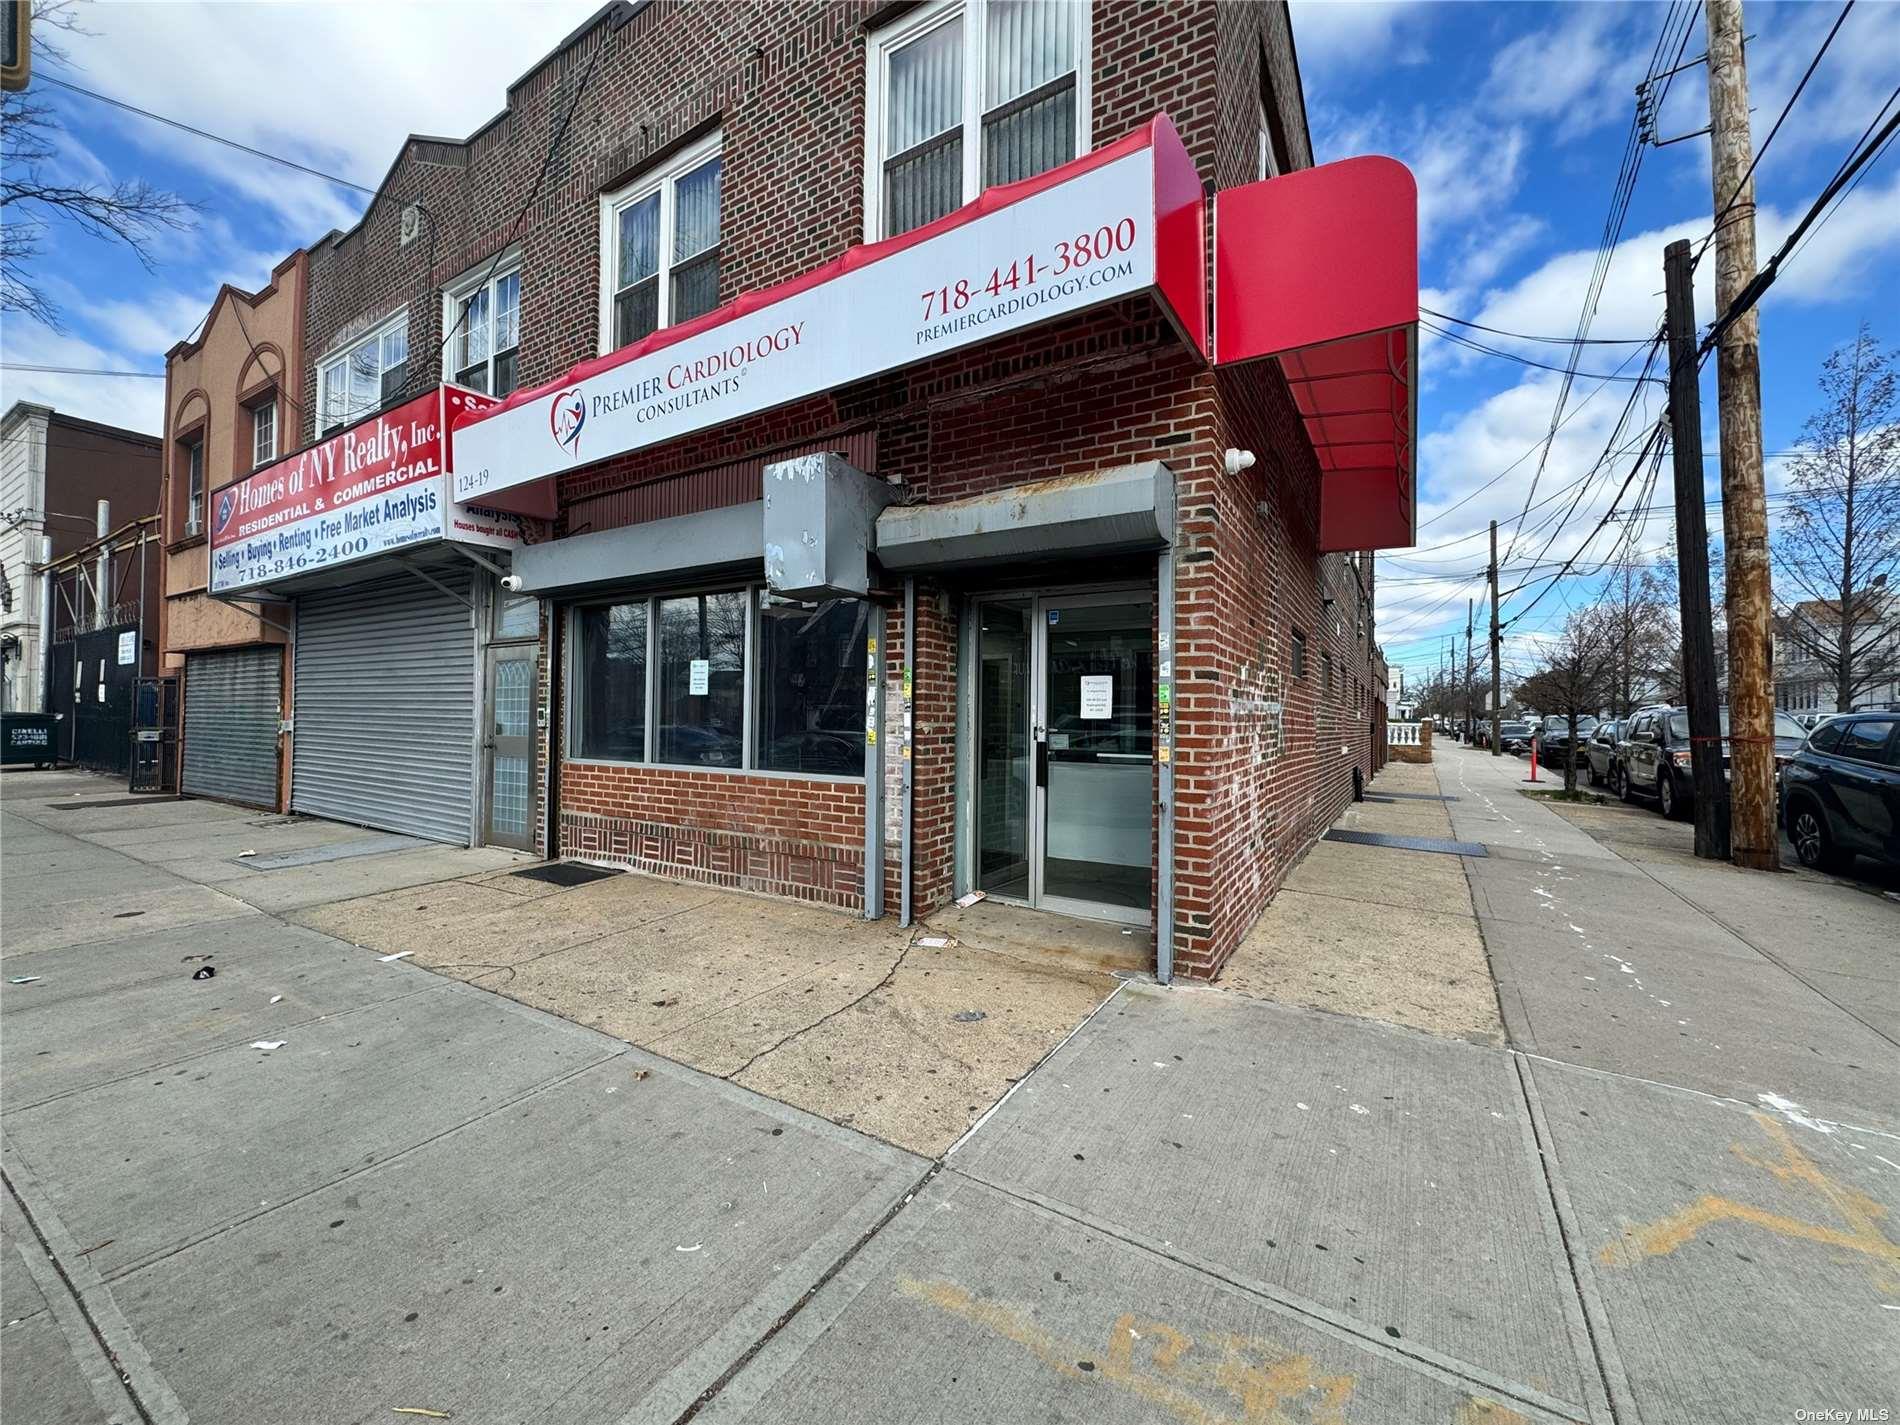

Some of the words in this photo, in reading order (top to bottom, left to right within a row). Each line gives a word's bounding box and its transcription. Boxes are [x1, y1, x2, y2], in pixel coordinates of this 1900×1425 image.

[916, 261, 1134, 345] PREMIERCARDIOLOGY.COM
[921, 217, 1136, 321] 718-441-3800
[592, 376, 664, 418] PREMIER
[667, 321, 806, 390] CARDIOLOGY
[636, 376, 740, 424] CONSULTANTS
[239, 477, 285, 515] Homes
[289, 452, 306, 495] of
[310, 440, 338, 488] NY
[343, 418, 408, 475] Realty,
[411, 421, 441, 448] Inc.
[239, 503, 310, 536] RESIDENTIAL
[315, 498, 325, 510] &
[333, 458, 439, 504] COMMERCIAL
[459, 468, 489, 492] 124-19
[219, 551, 240, 570] Selling
[247, 541, 272, 563] Buying
[279, 528, 311, 552] Renting
[320, 520, 341, 540] Free
[344, 504, 380, 533] Market
[384, 488, 437, 522] Analysis
[239, 537, 368, 582] 718-846-2400
[454, 519, 475, 532] Houses
